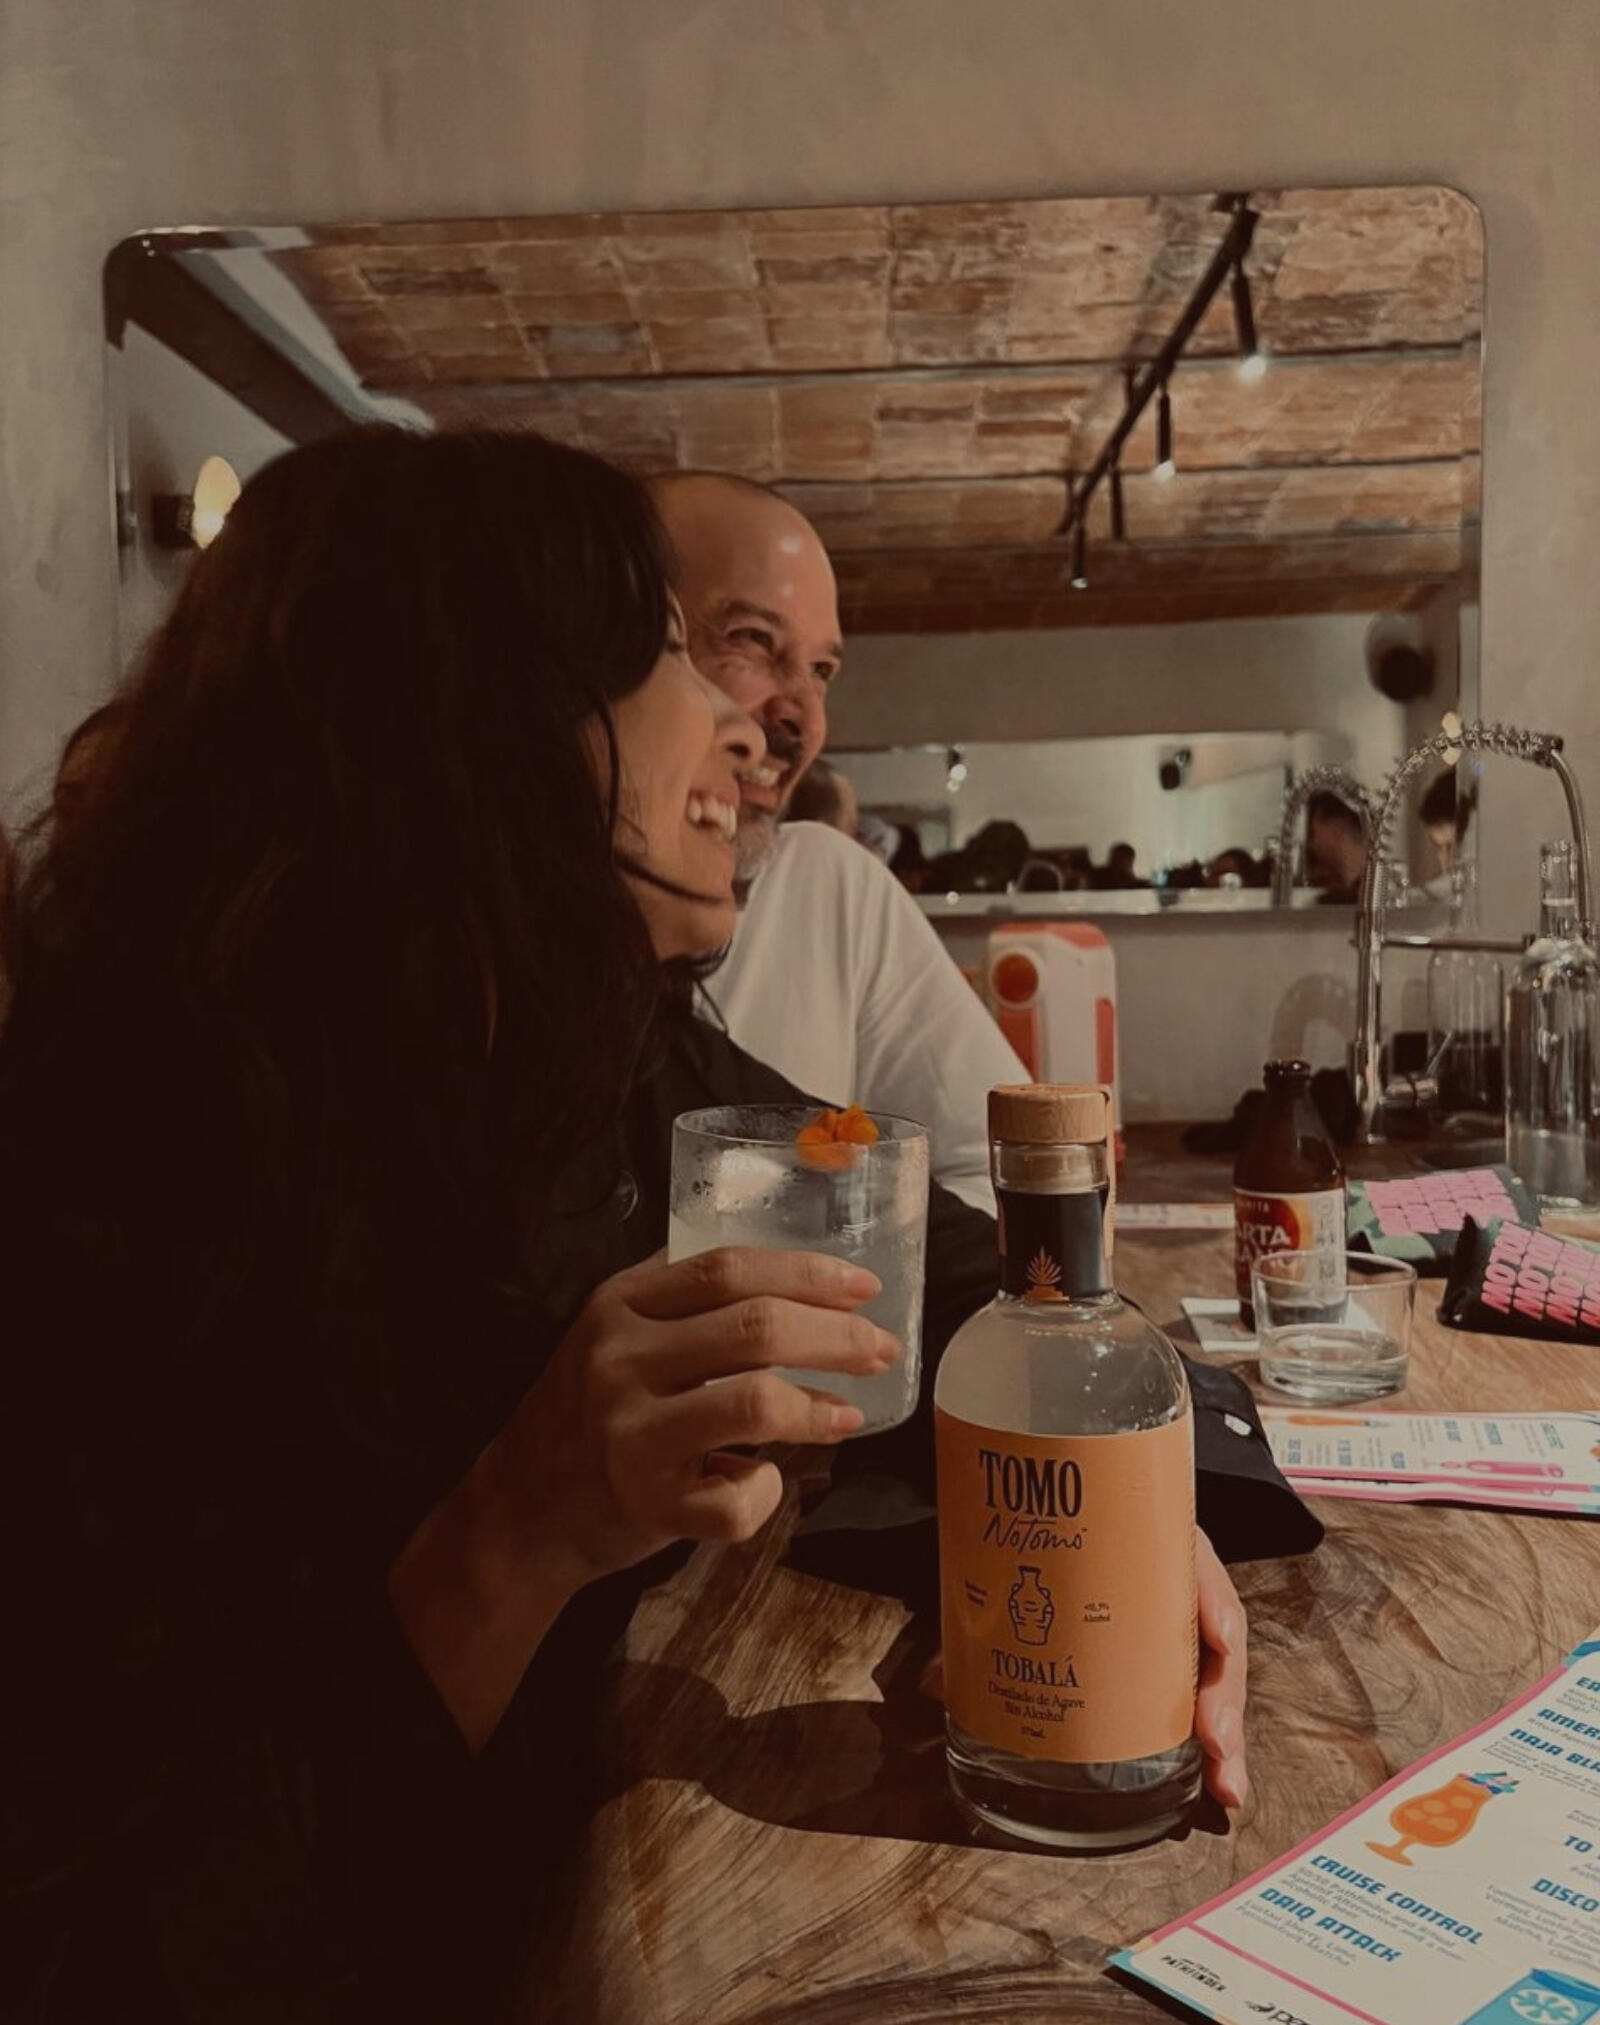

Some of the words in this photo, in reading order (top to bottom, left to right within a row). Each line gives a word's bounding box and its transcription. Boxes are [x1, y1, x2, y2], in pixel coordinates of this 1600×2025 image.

[979, 1448, 1082, 1518] TOMO
[991, 1647, 1081, 1689] TOBALÁ
[1508, 1728, 1564, 1756] NAJA
[1537, 1708, 1600, 1741] AMER
[1563, 1835, 1593, 1852] TO
[1310, 1855, 1386, 1895] CRUISE
[1385, 1891, 1483, 1945] CONTROL
[1531, 1878, 1600, 1913] DISCO
[1315, 1916, 1403, 1962] ATTACK
